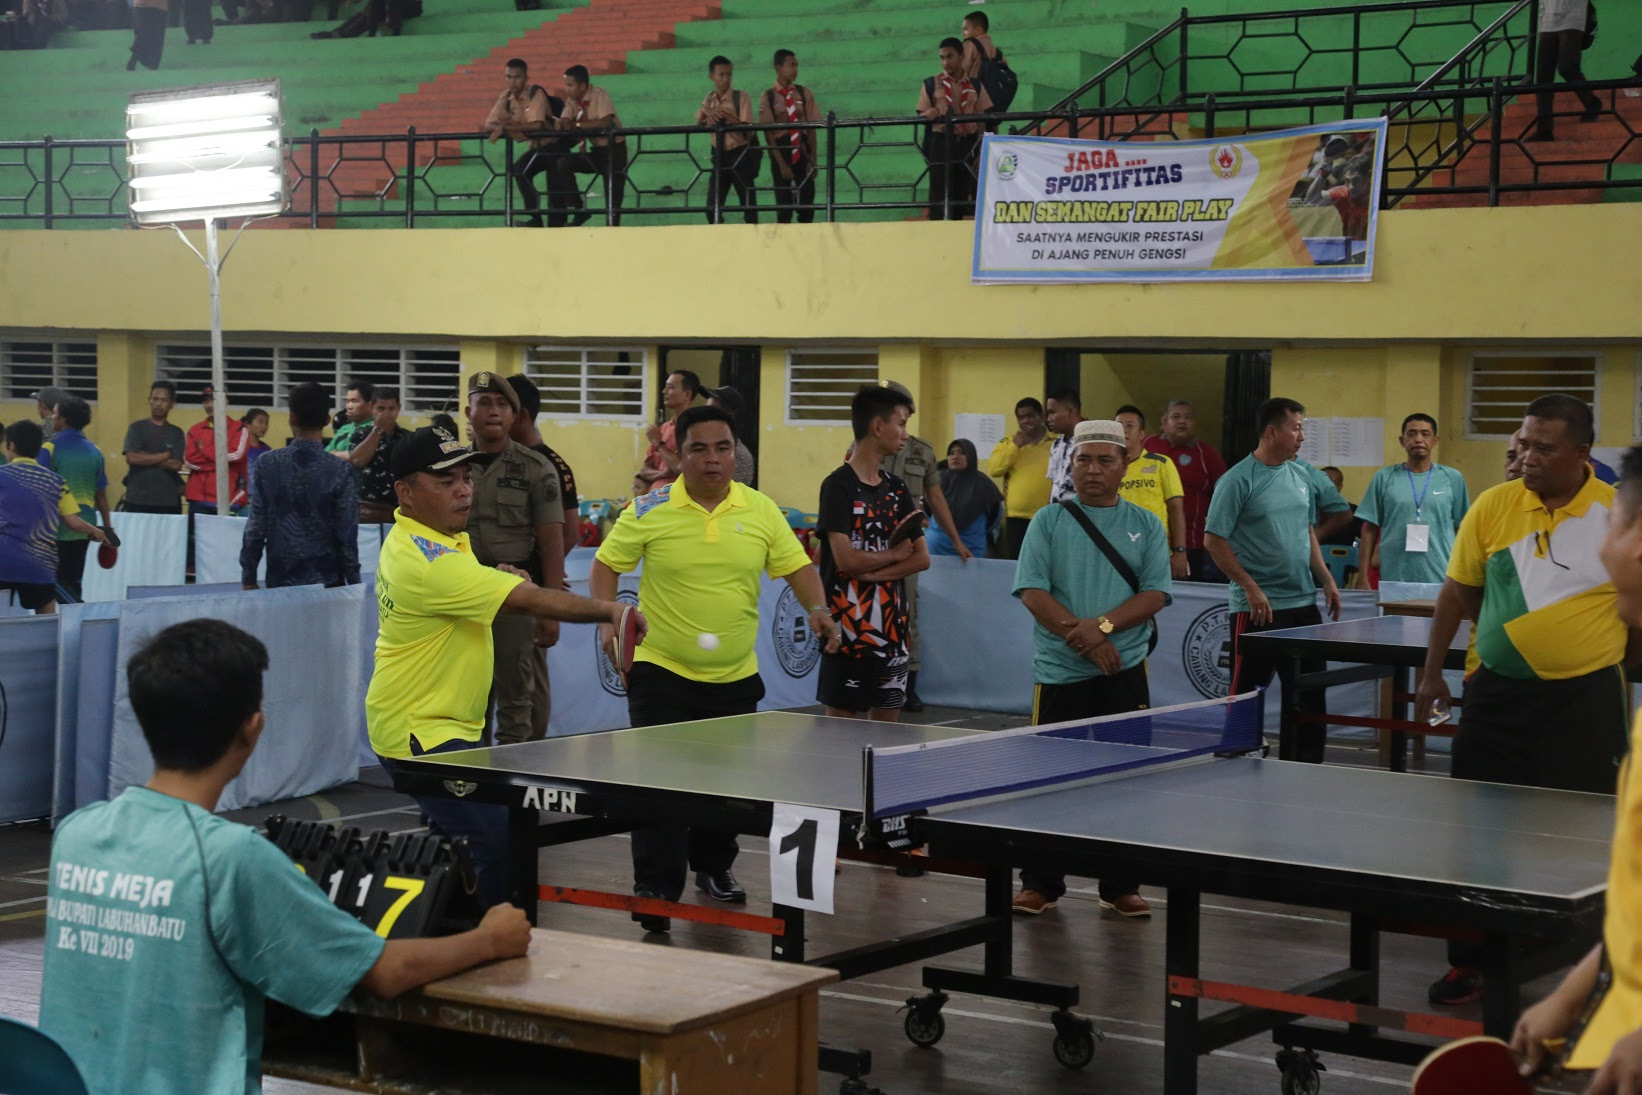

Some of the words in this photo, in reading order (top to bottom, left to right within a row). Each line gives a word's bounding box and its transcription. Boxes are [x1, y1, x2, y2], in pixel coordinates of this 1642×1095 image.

[1064, 149, 1119, 173] JAGA
[1045, 164, 1182, 195] SPORTIFITAS
[994, 201, 1034, 223] DAN
[1035, 200, 1132, 223] SEMANGAT
[1133, 200, 1180, 222] FAIR
[1180, 199, 1233, 222] PLAY
[1016, 232, 1072, 243] SAATNYA
[1076, 231, 1140, 243] MENGUKIR
[1144, 231, 1203, 242] PRESTASI
[1031, 249, 1044, 260] DI
[1049, 249, 1089, 260] AJANG
[1093, 249, 1135, 260] PENUH
[1138, 248, 1186, 259] GENGSI
[779, 818, 818, 901] 1
[56, 861, 109, 896] TENIS
[109, 872, 174, 909] MEJA
[328, 869, 344, 903] 1
[355, 873, 374, 907] 1
[375, 875, 426, 939] 7
[57, 900, 97, 927] BUPATI
[97, 907, 186, 942] LABUHANBATU
[57, 926, 78, 950] Ke
[80, 930, 100, 955] VII
[100, 934, 135, 961] 2019
